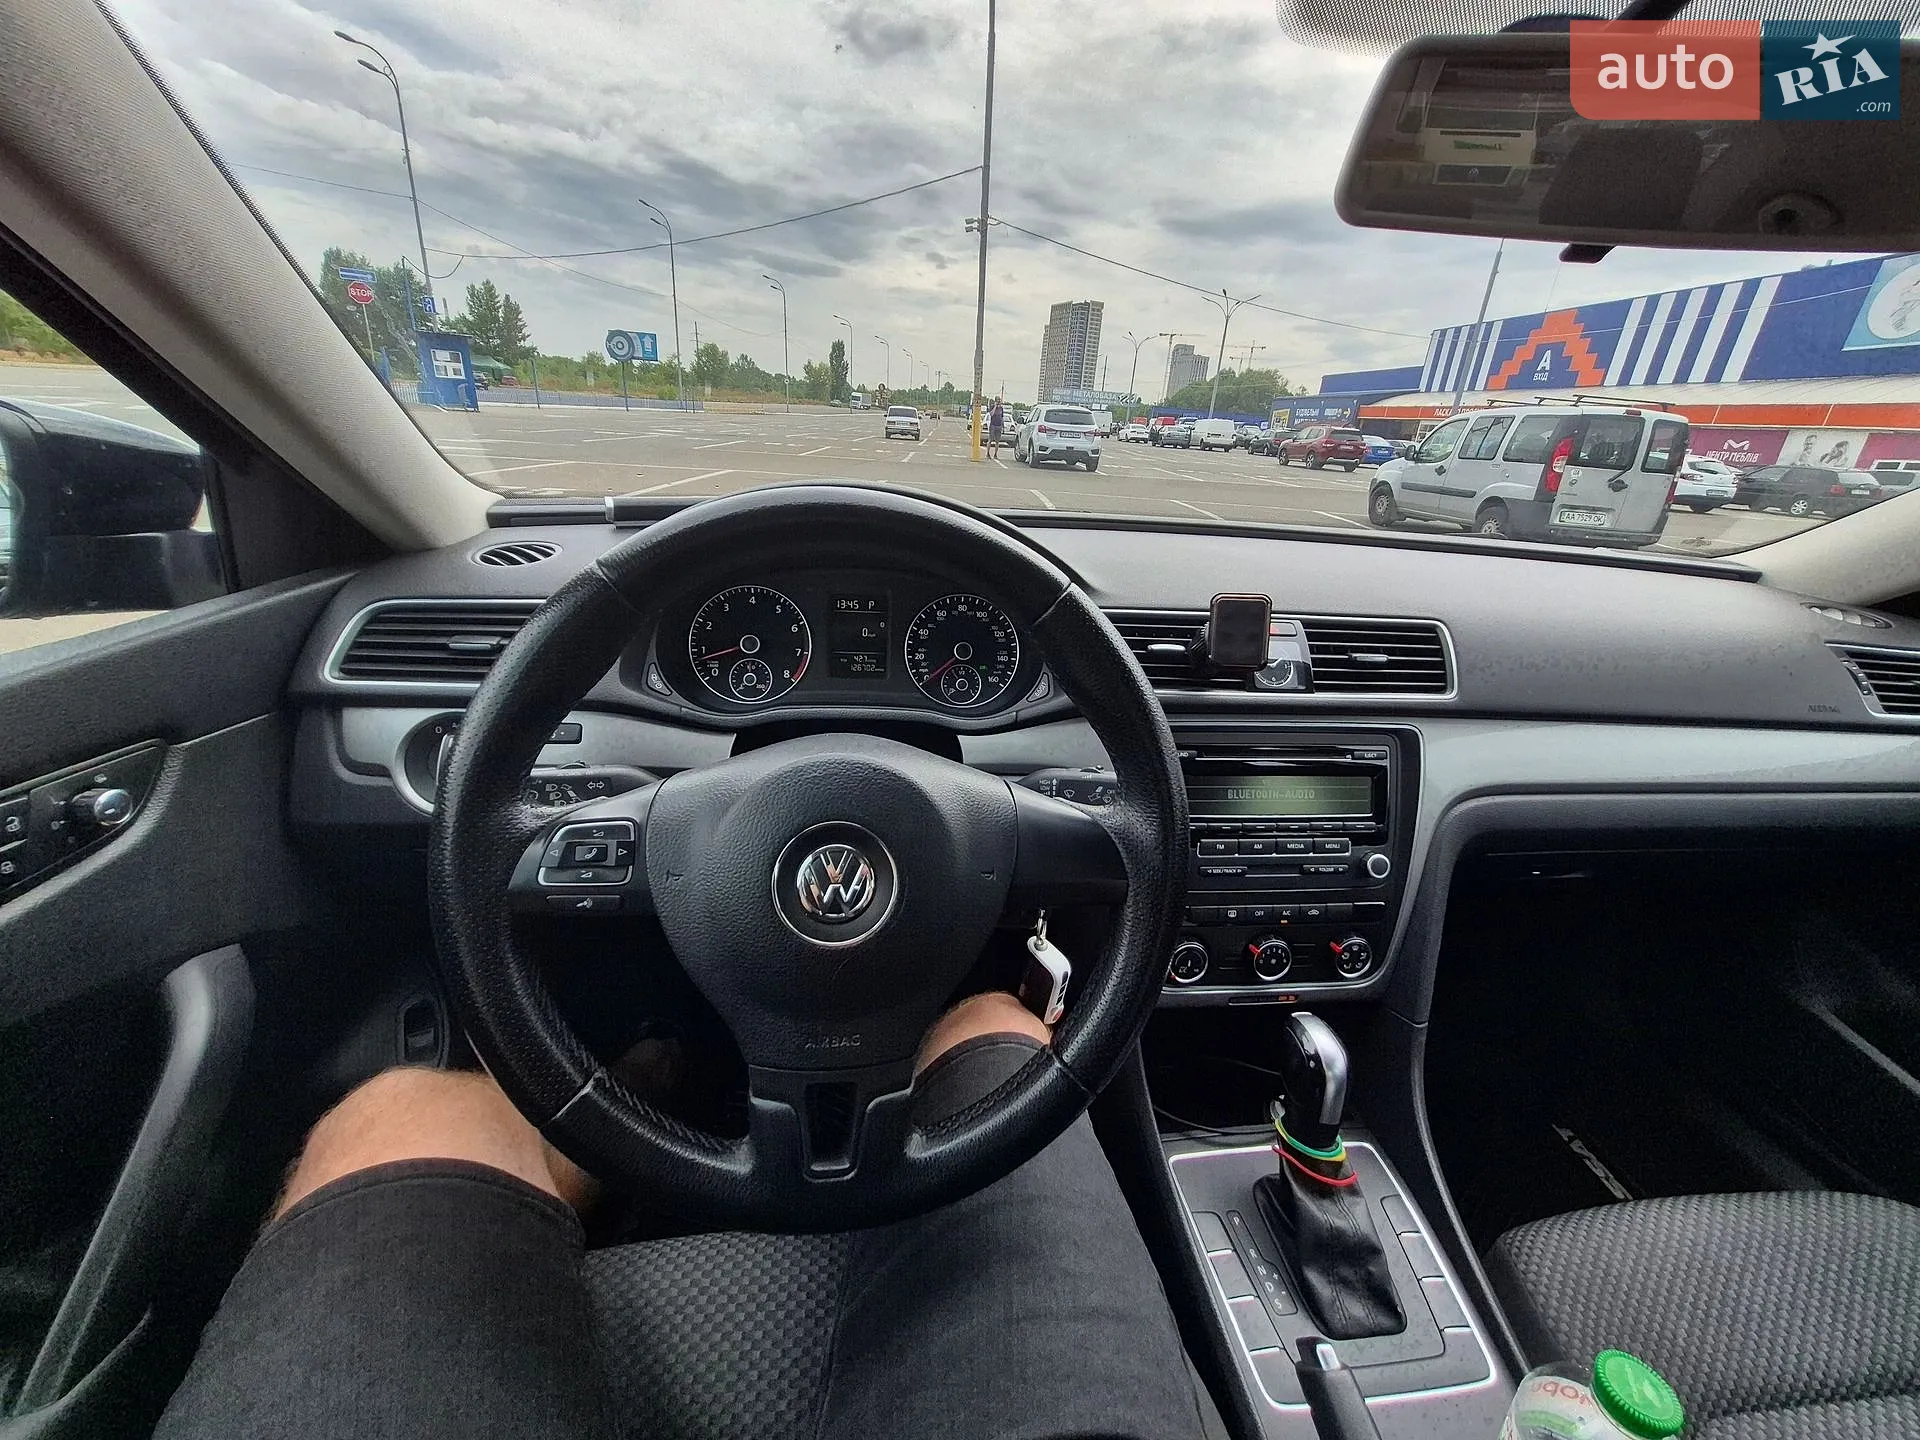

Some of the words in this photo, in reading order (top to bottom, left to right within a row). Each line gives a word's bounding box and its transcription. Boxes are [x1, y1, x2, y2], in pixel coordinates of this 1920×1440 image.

[350, 288, 372, 297] STOP
[749, 596, 756, 604] 4
[723, 603, 729, 612] 3
[868, 600, 875, 609] P
[775, 605, 781, 613] 5
[706, 622, 712, 630] 2
[791, 624, 798, 632] 6
[701, 646, 706, 654] 1
[795, 649, 801, 657] 7
[711, 668, 719, 676] 0
[783, 670, 790, 678] 8
[1233, 1216, 1240, 1226] P
[1249, 1248, 1257, 1258] R
[1257, 1265, 1267, 1276] N
[1265, 1281, 1274, 1292] D
[1274, 1298, 1282, 1309] S
